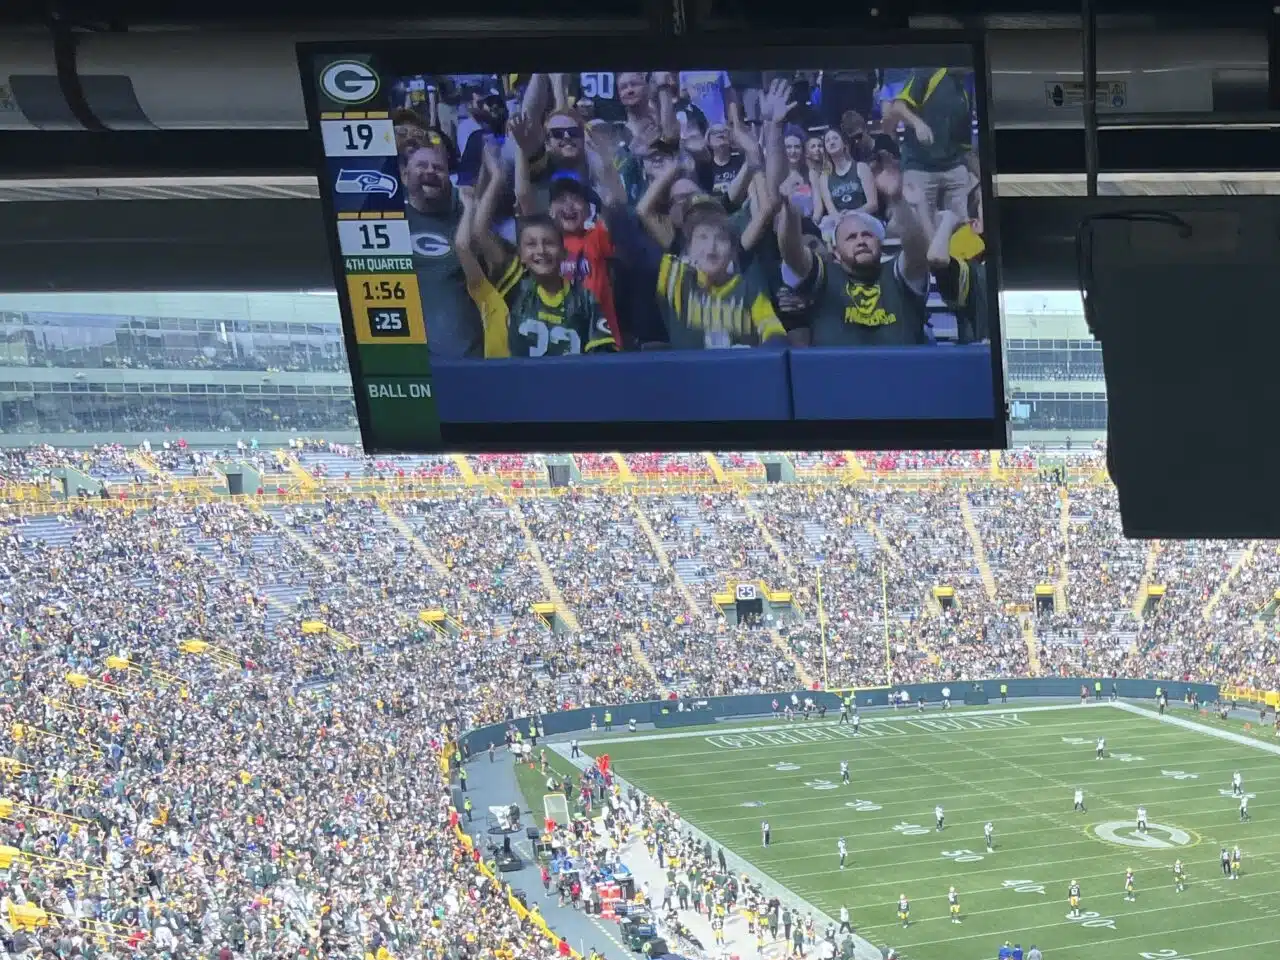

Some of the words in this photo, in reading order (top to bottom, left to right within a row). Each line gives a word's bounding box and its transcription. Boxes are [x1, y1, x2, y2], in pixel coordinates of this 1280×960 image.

[342, 123, 374, 150] 19
[359, 224, 391, 250] 15
[345, 257, 365, 271] 4TH
[366, 256, 414, 272] QUARTER
[362, 281, 406, 300] 1:56
[375, 312, 402, 330] :25
[368, 383, 407, 399] BALL
[410, 382, 432, 398] ON
